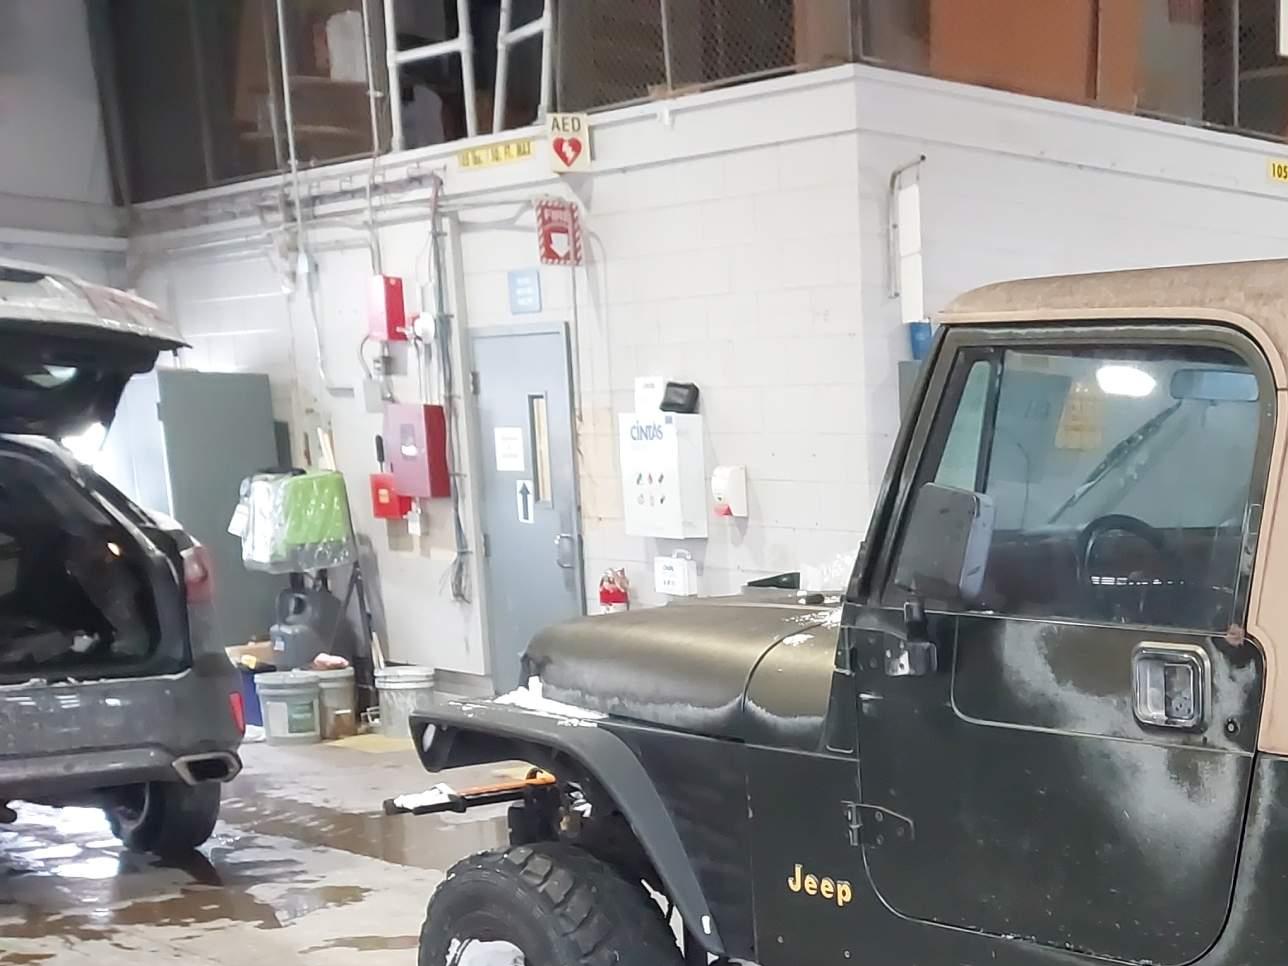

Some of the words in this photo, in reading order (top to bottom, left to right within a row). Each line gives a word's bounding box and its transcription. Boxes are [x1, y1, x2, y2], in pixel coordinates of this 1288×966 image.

[551, 116, 582, 132] AED
[1271, 163, 1288, 179] 105
[786, 862, 853, 908] Jeep
